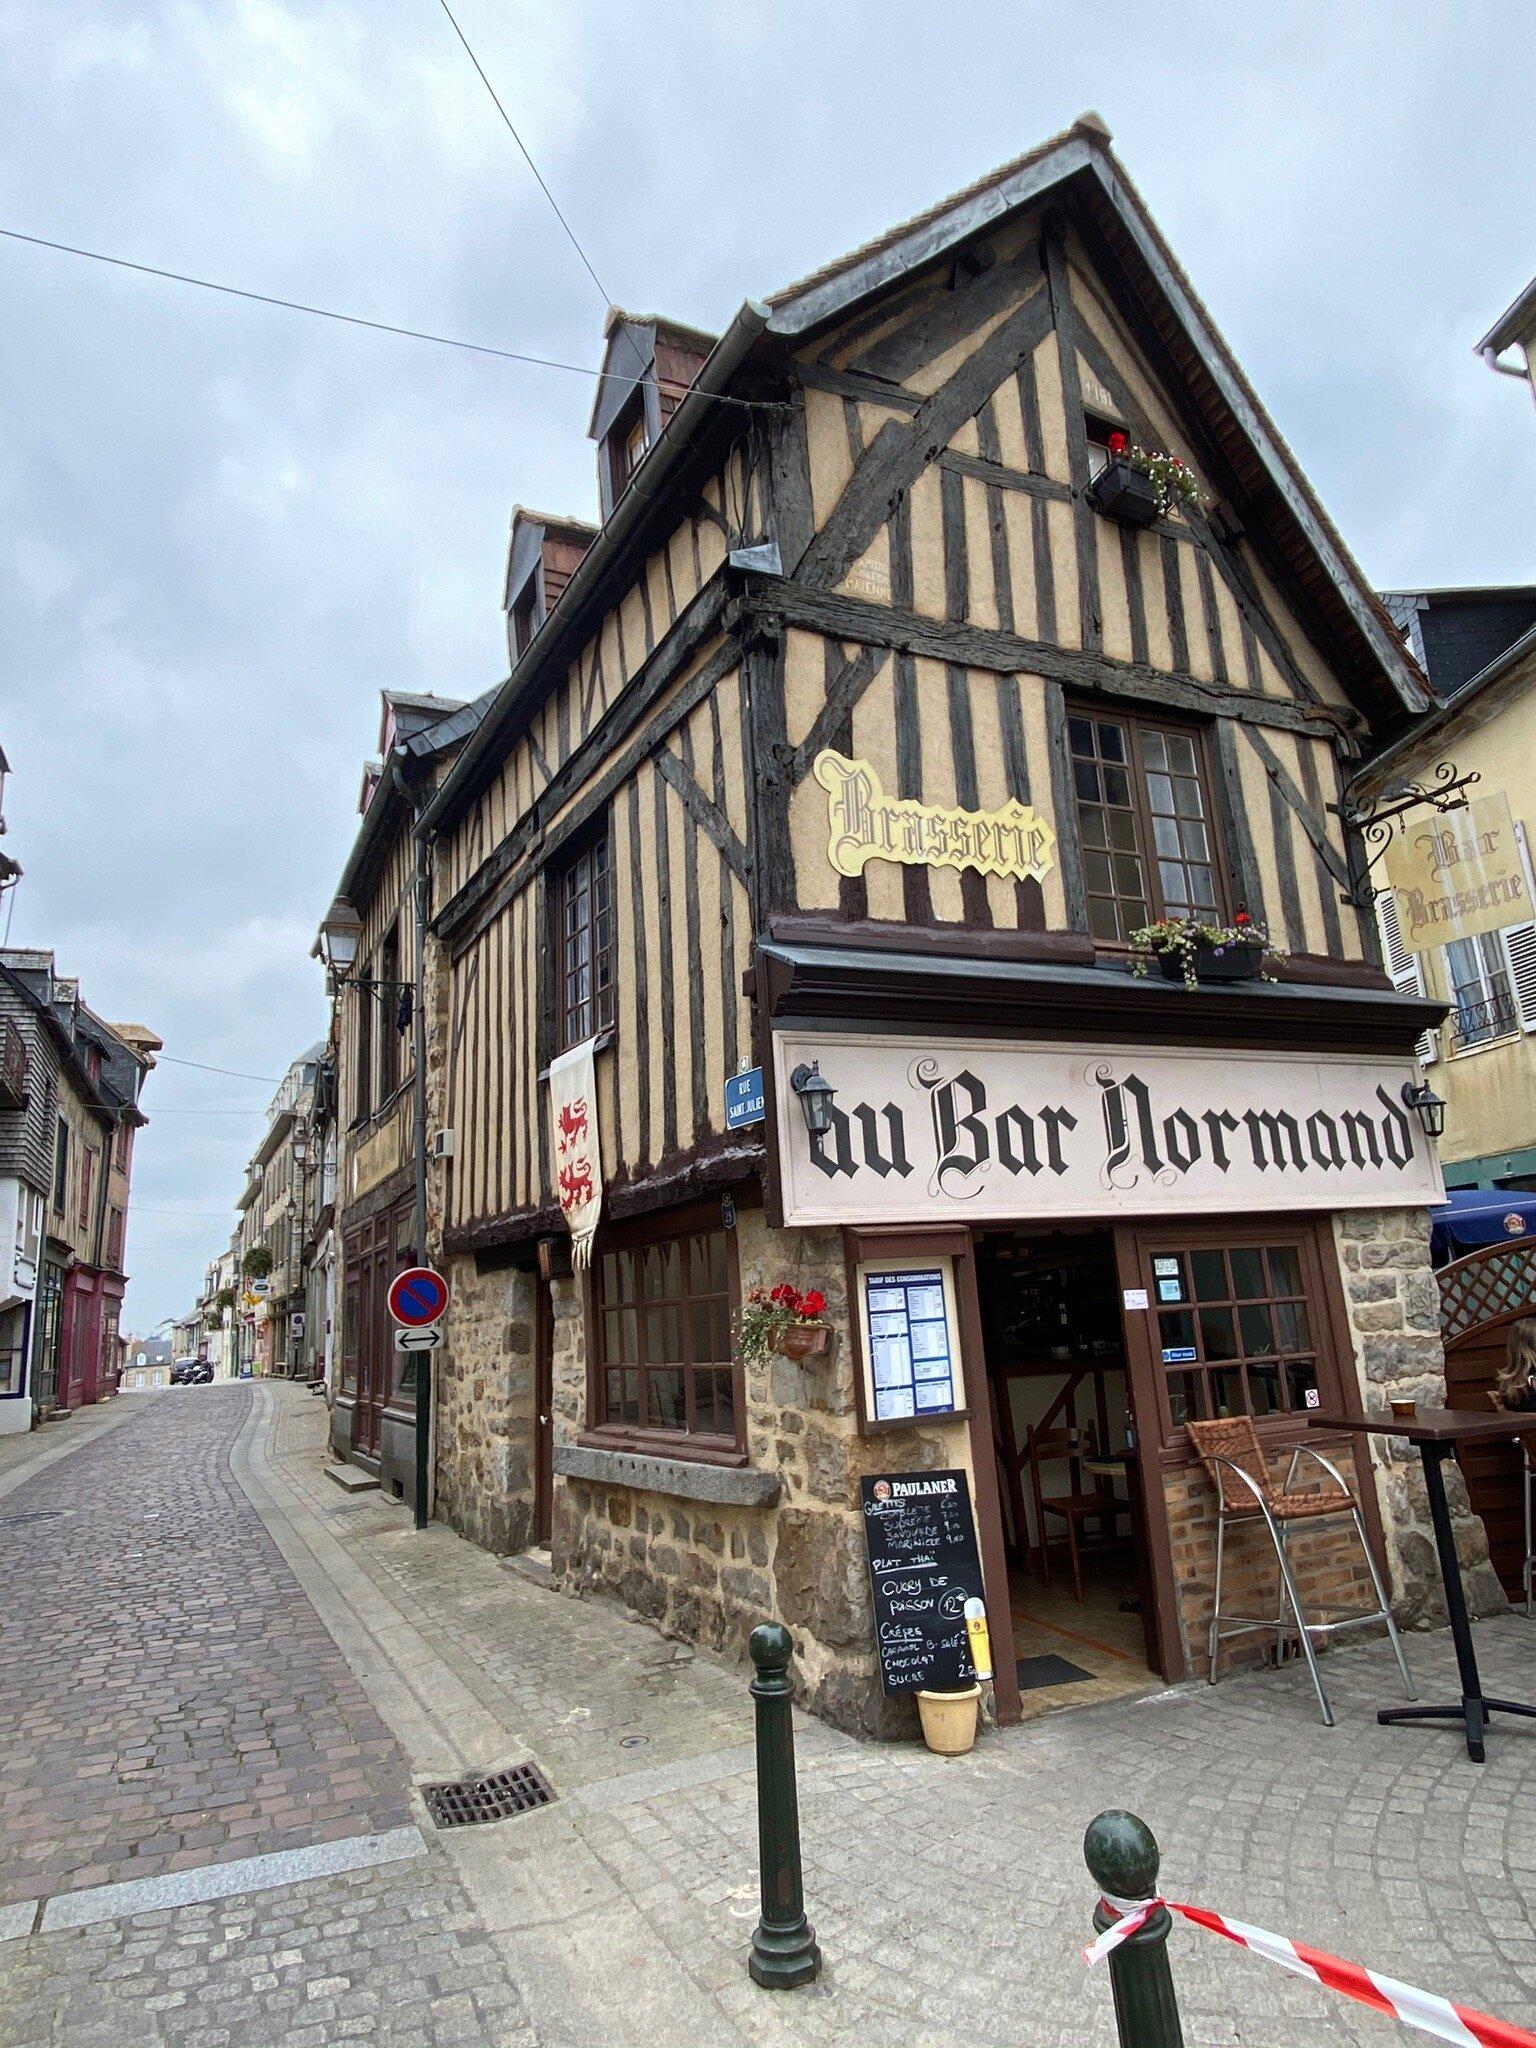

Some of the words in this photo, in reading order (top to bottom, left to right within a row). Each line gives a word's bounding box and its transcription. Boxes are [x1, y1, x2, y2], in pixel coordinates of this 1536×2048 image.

[819, 754, 1048, 876] Brasserie
[738, 1080, 751, 1096] RUE
[907, 1056, 1078, 1199] Bar
[1084, 1059, 1415, 1191] Normand
[892, 1478, 958, 1498] PAULANER
[872, 1559, 902, 1571] PLAT
[929, 1577, 949, 1587] DE
[888, 1671, 925, 1686] SUCRE
